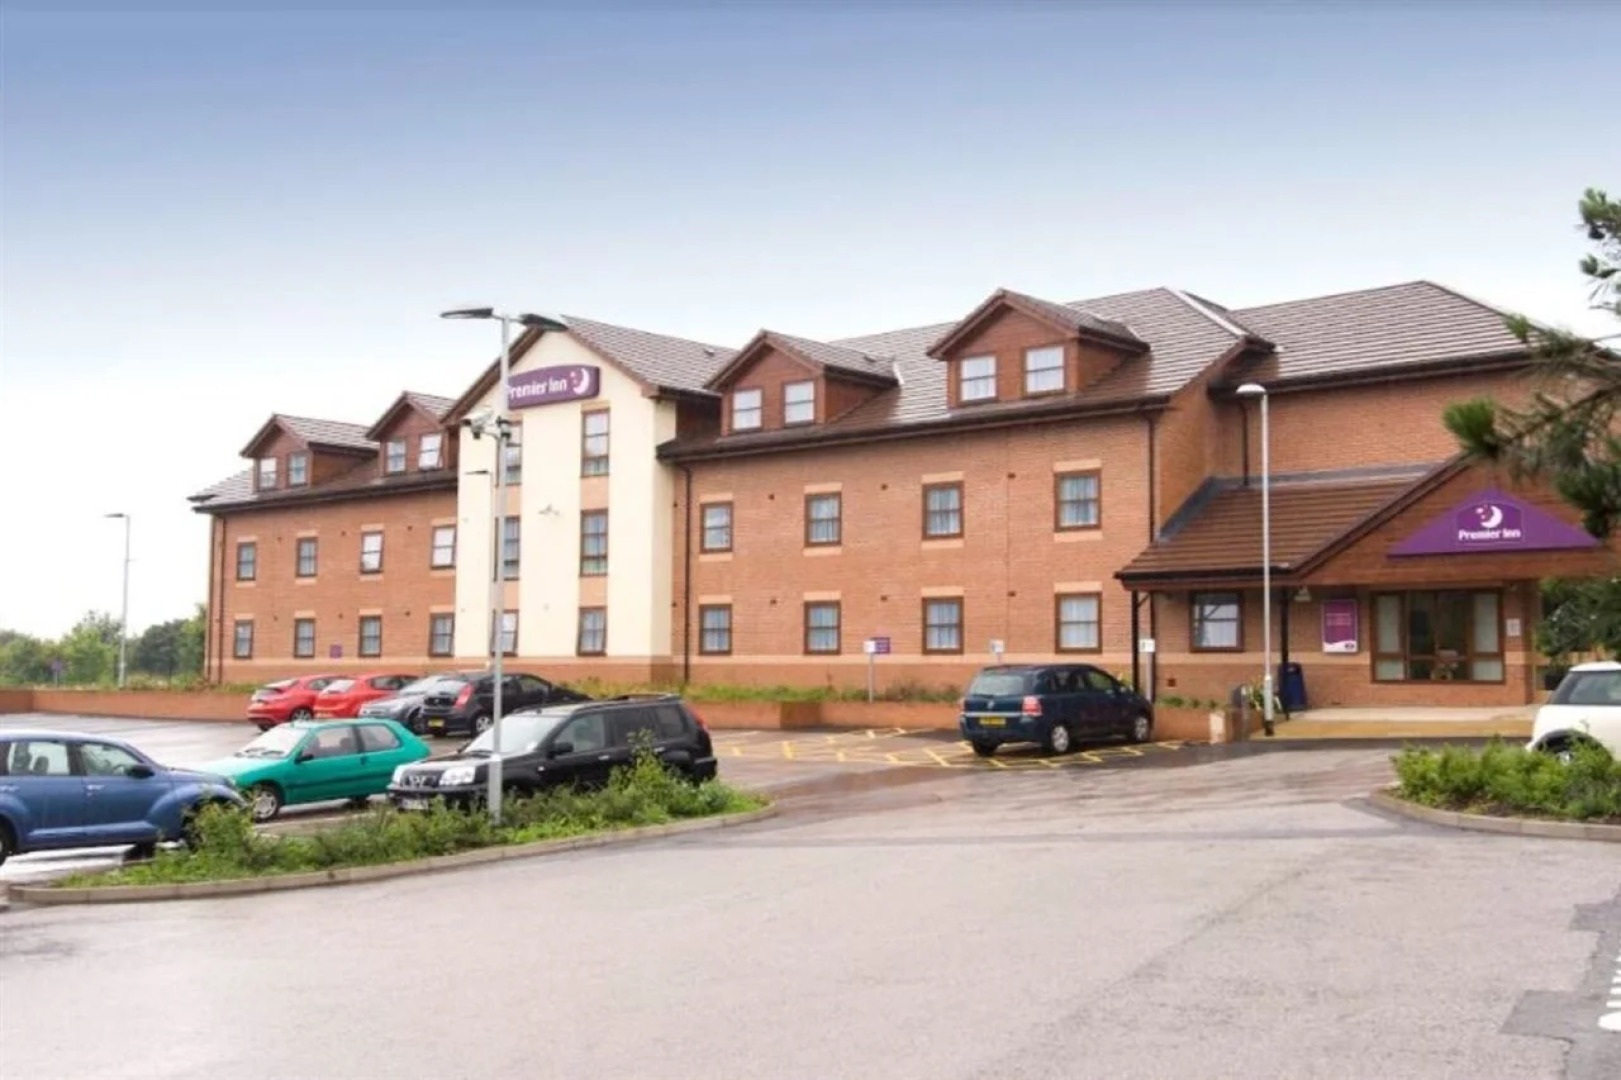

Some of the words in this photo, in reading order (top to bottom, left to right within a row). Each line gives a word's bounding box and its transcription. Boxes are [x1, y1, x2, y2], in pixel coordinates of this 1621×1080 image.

[548, 377, 567, 393] Inn
[1458, 529, 1501, 541] Premier
[1502, 528, 1521, 538] Inn
